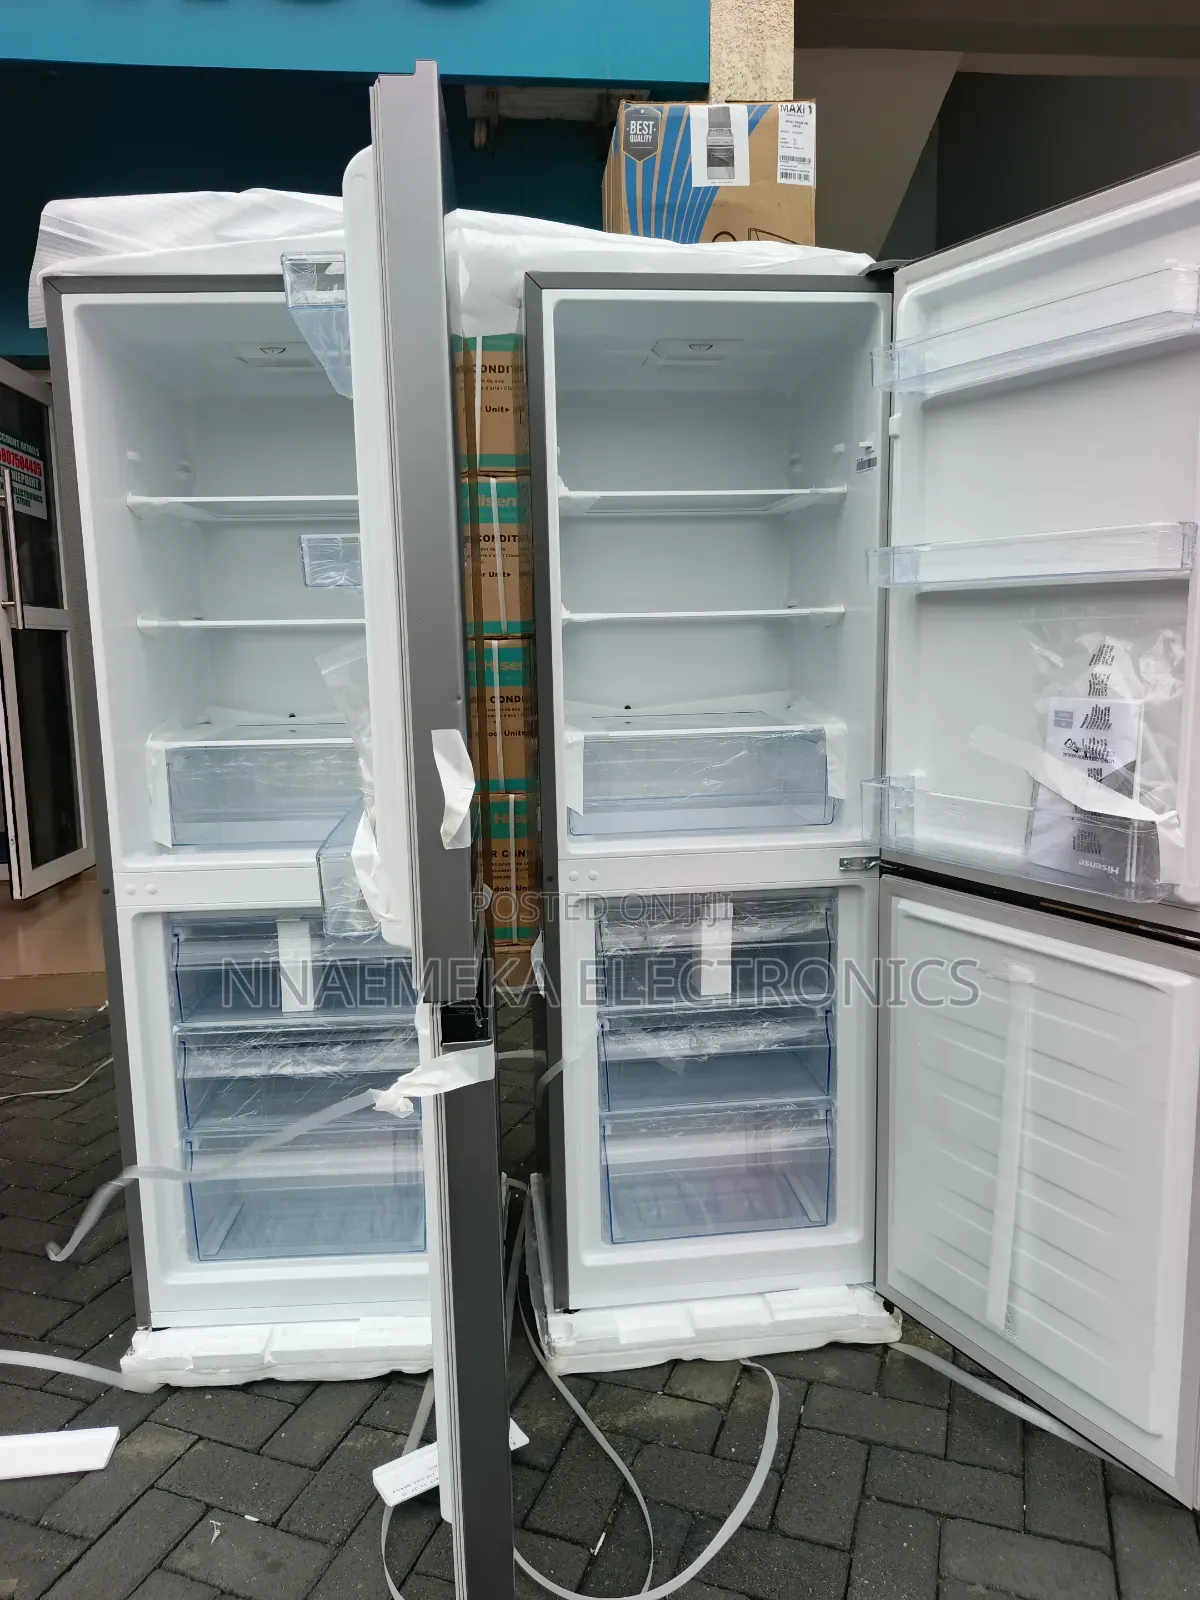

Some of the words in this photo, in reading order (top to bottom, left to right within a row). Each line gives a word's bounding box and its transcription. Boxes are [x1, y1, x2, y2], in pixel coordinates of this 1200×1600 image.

[780, 104, 805, 114] MAXI
[630, 120, 654, 134] BEST
[629, 134, 652, 143] QUALITY
[485, 405, 504, 413] Unit
[16, 496, 31, 508] STORE
[1078, 859, 1119, 875] Hisense
